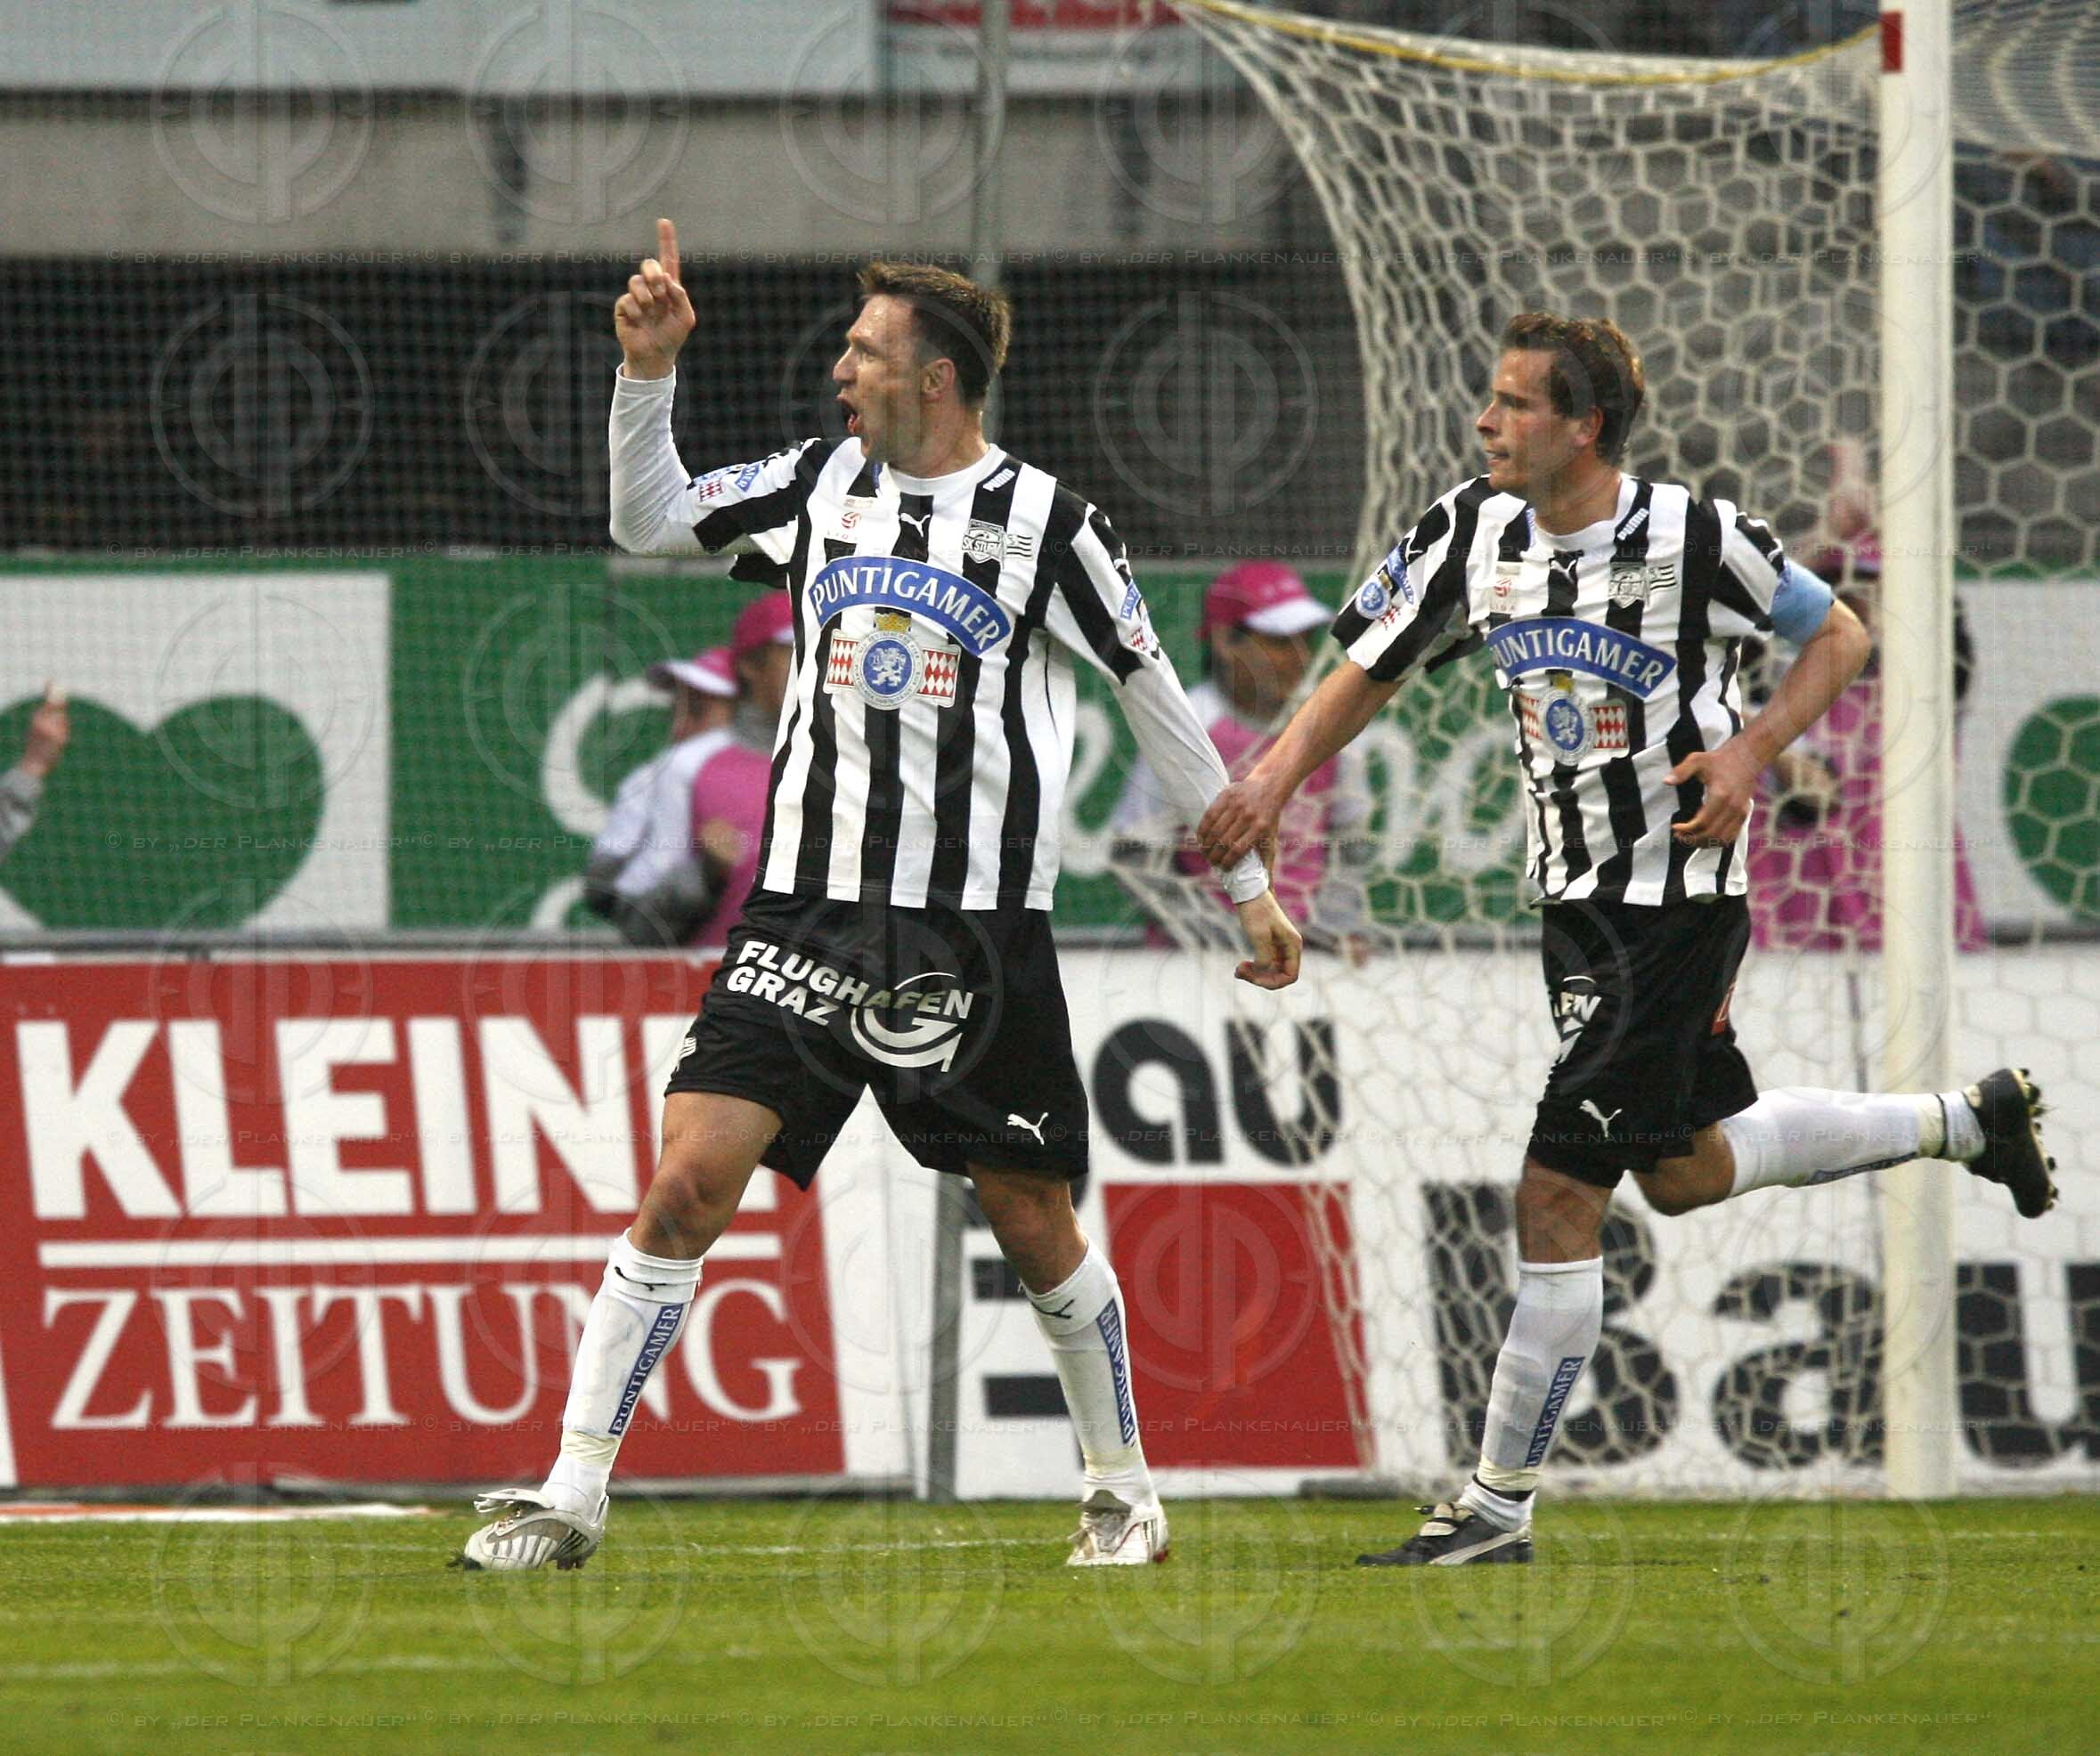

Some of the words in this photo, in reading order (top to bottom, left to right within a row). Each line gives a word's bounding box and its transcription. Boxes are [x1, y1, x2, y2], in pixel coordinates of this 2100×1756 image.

[812, 566, 1001, 651] PUNTIGAMER
[726, 965, 840, 1026] GRAZ
[736, 939, 974, 1020] FLUGHAFEN
[1092, 1017, 1345, 1168] au
[612, 1306, 680, 1432] PUNTIGAMER
[1526, 1360, 1582, 1467] UNTIGAMER
